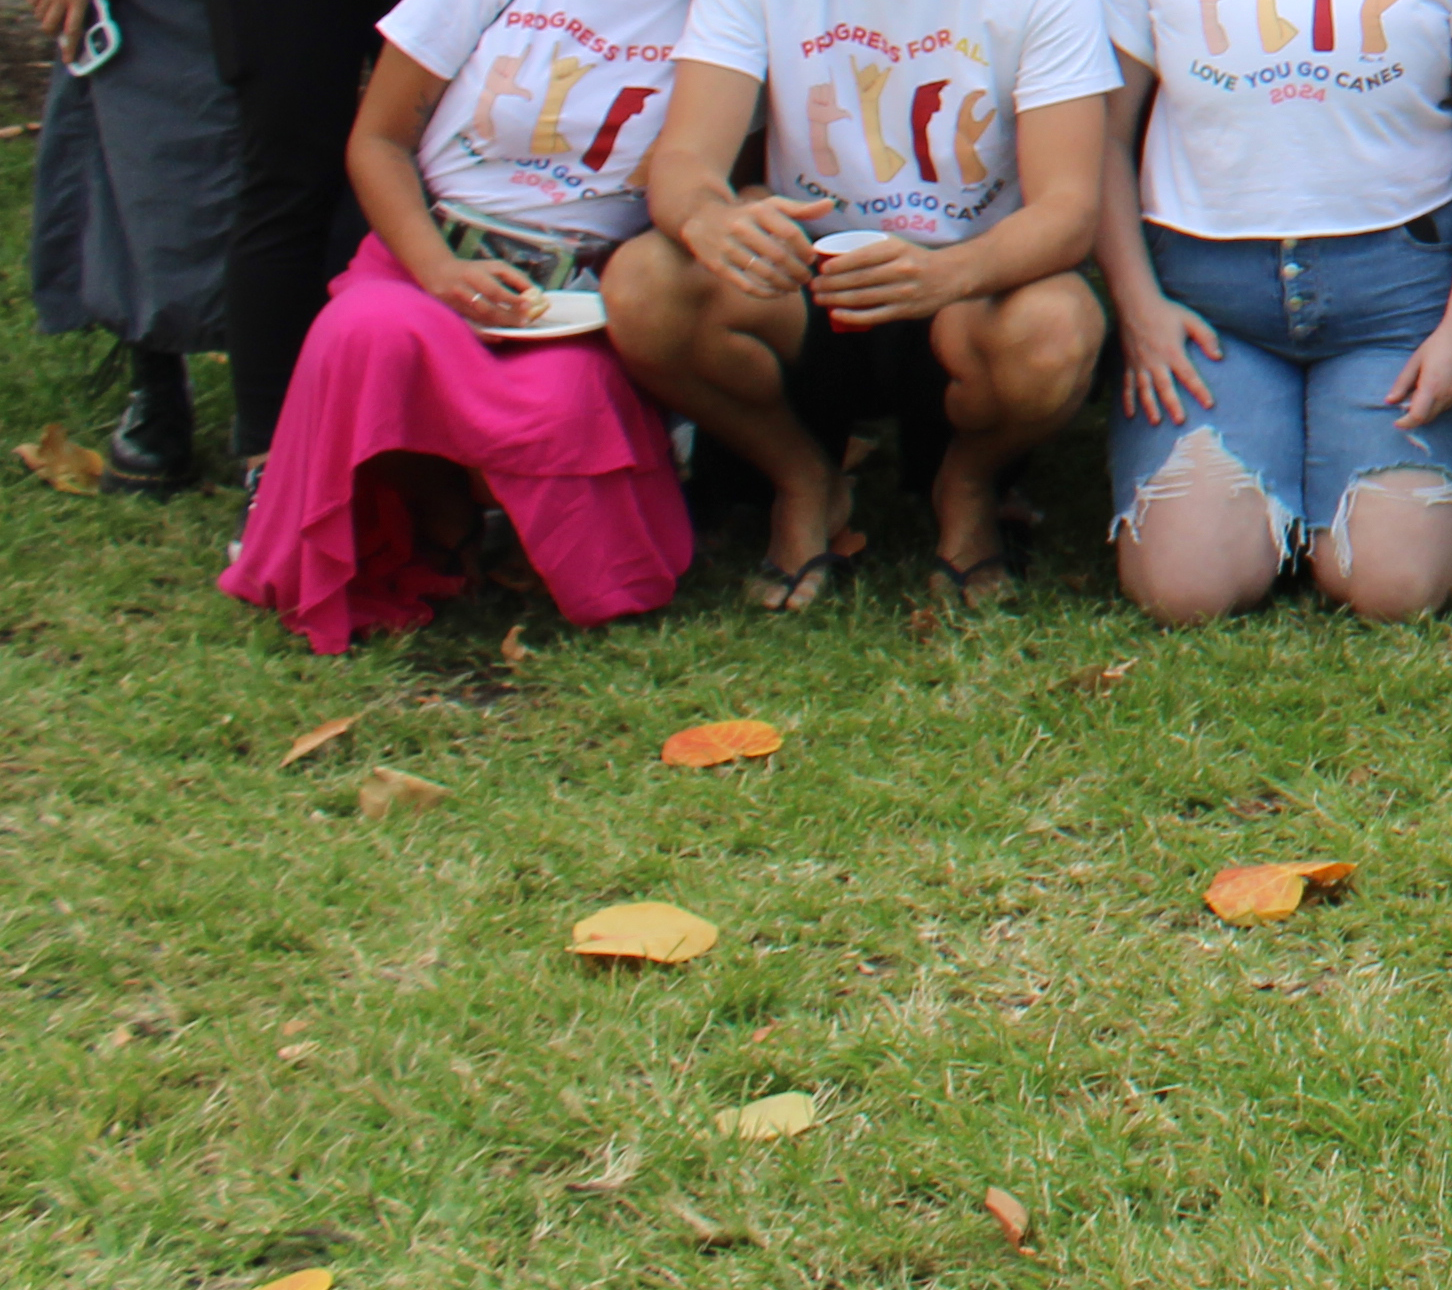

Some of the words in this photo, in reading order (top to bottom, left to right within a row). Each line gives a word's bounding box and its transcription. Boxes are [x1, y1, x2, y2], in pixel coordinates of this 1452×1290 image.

[507, 11, 619, 62] PROGRESS
[908, 28, 952, 60] FOR
[1190, 59, 1238, 92] LOVE
[1244, 61, 1291, 89] YOU
[1298, 60, 1330, 81] GO
[1336, 60, 1404, 92] CANES
[1271, 83, 1325, 105] 2024
[552, 165, 582, 187] GO
[856, 192, 903, 214] YOU
[906, 190, 940, 211] GO
[881, 215, 937, 233] 2024
